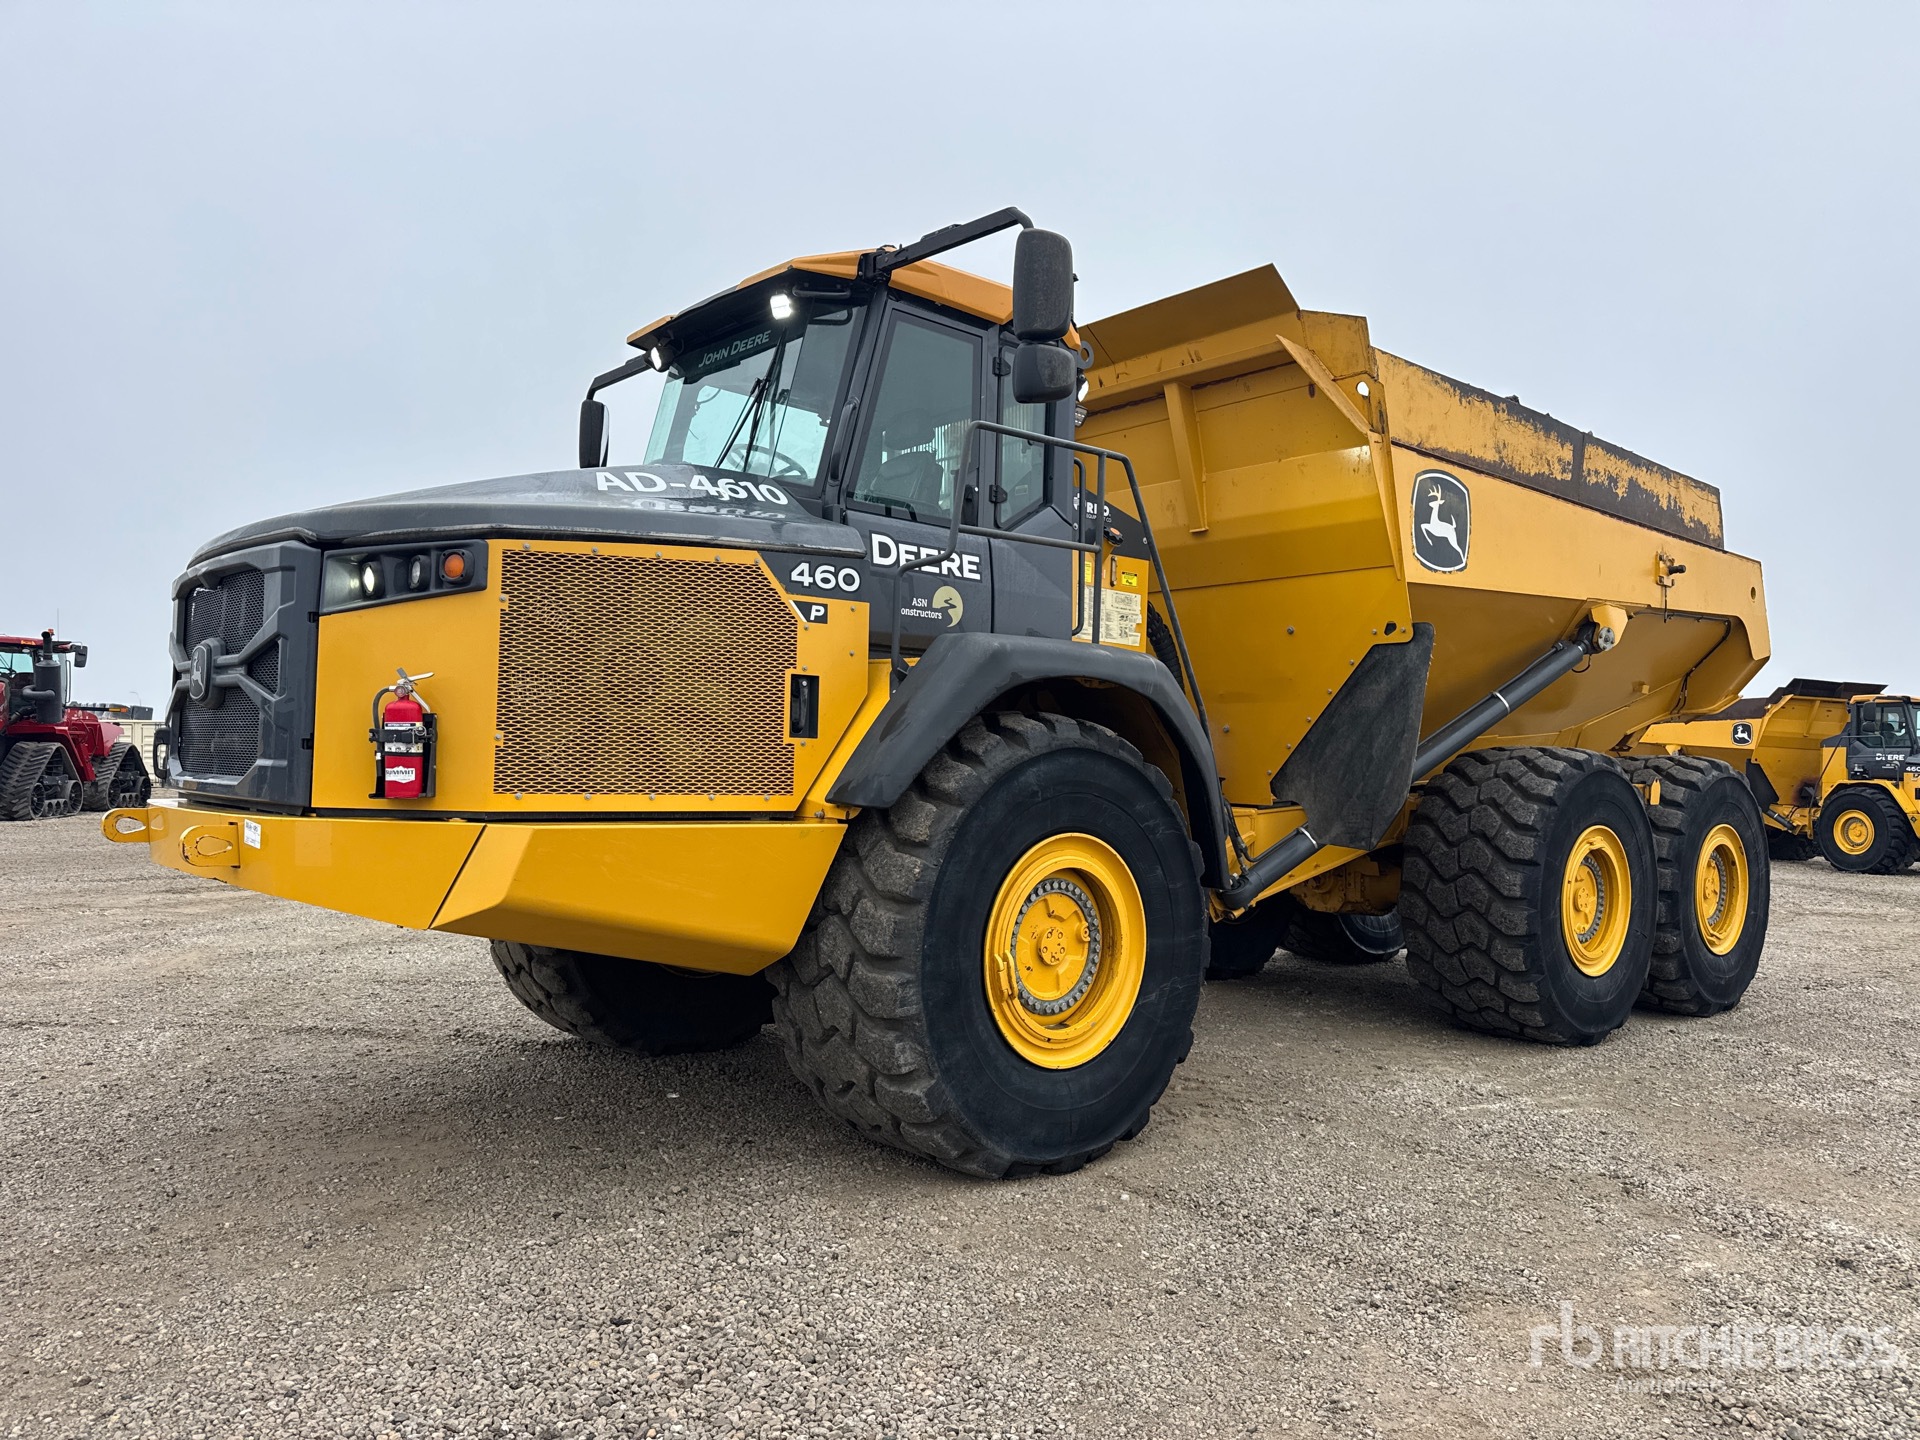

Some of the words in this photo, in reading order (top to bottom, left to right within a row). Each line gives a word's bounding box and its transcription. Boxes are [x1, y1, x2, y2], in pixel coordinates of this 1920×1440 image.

[698, 346, 730, 368] JOHN
[730, 330, 772, 356] DEERE
[595, 471, 789, 505] AD-4610
[871, 533, 981, 581] DEERE
[790, 562, 861, 593] 460
[809, 604, 825, 621] P
[900, 607, 942, 620] onstructors
[911, 597, 928, 607] ASN
